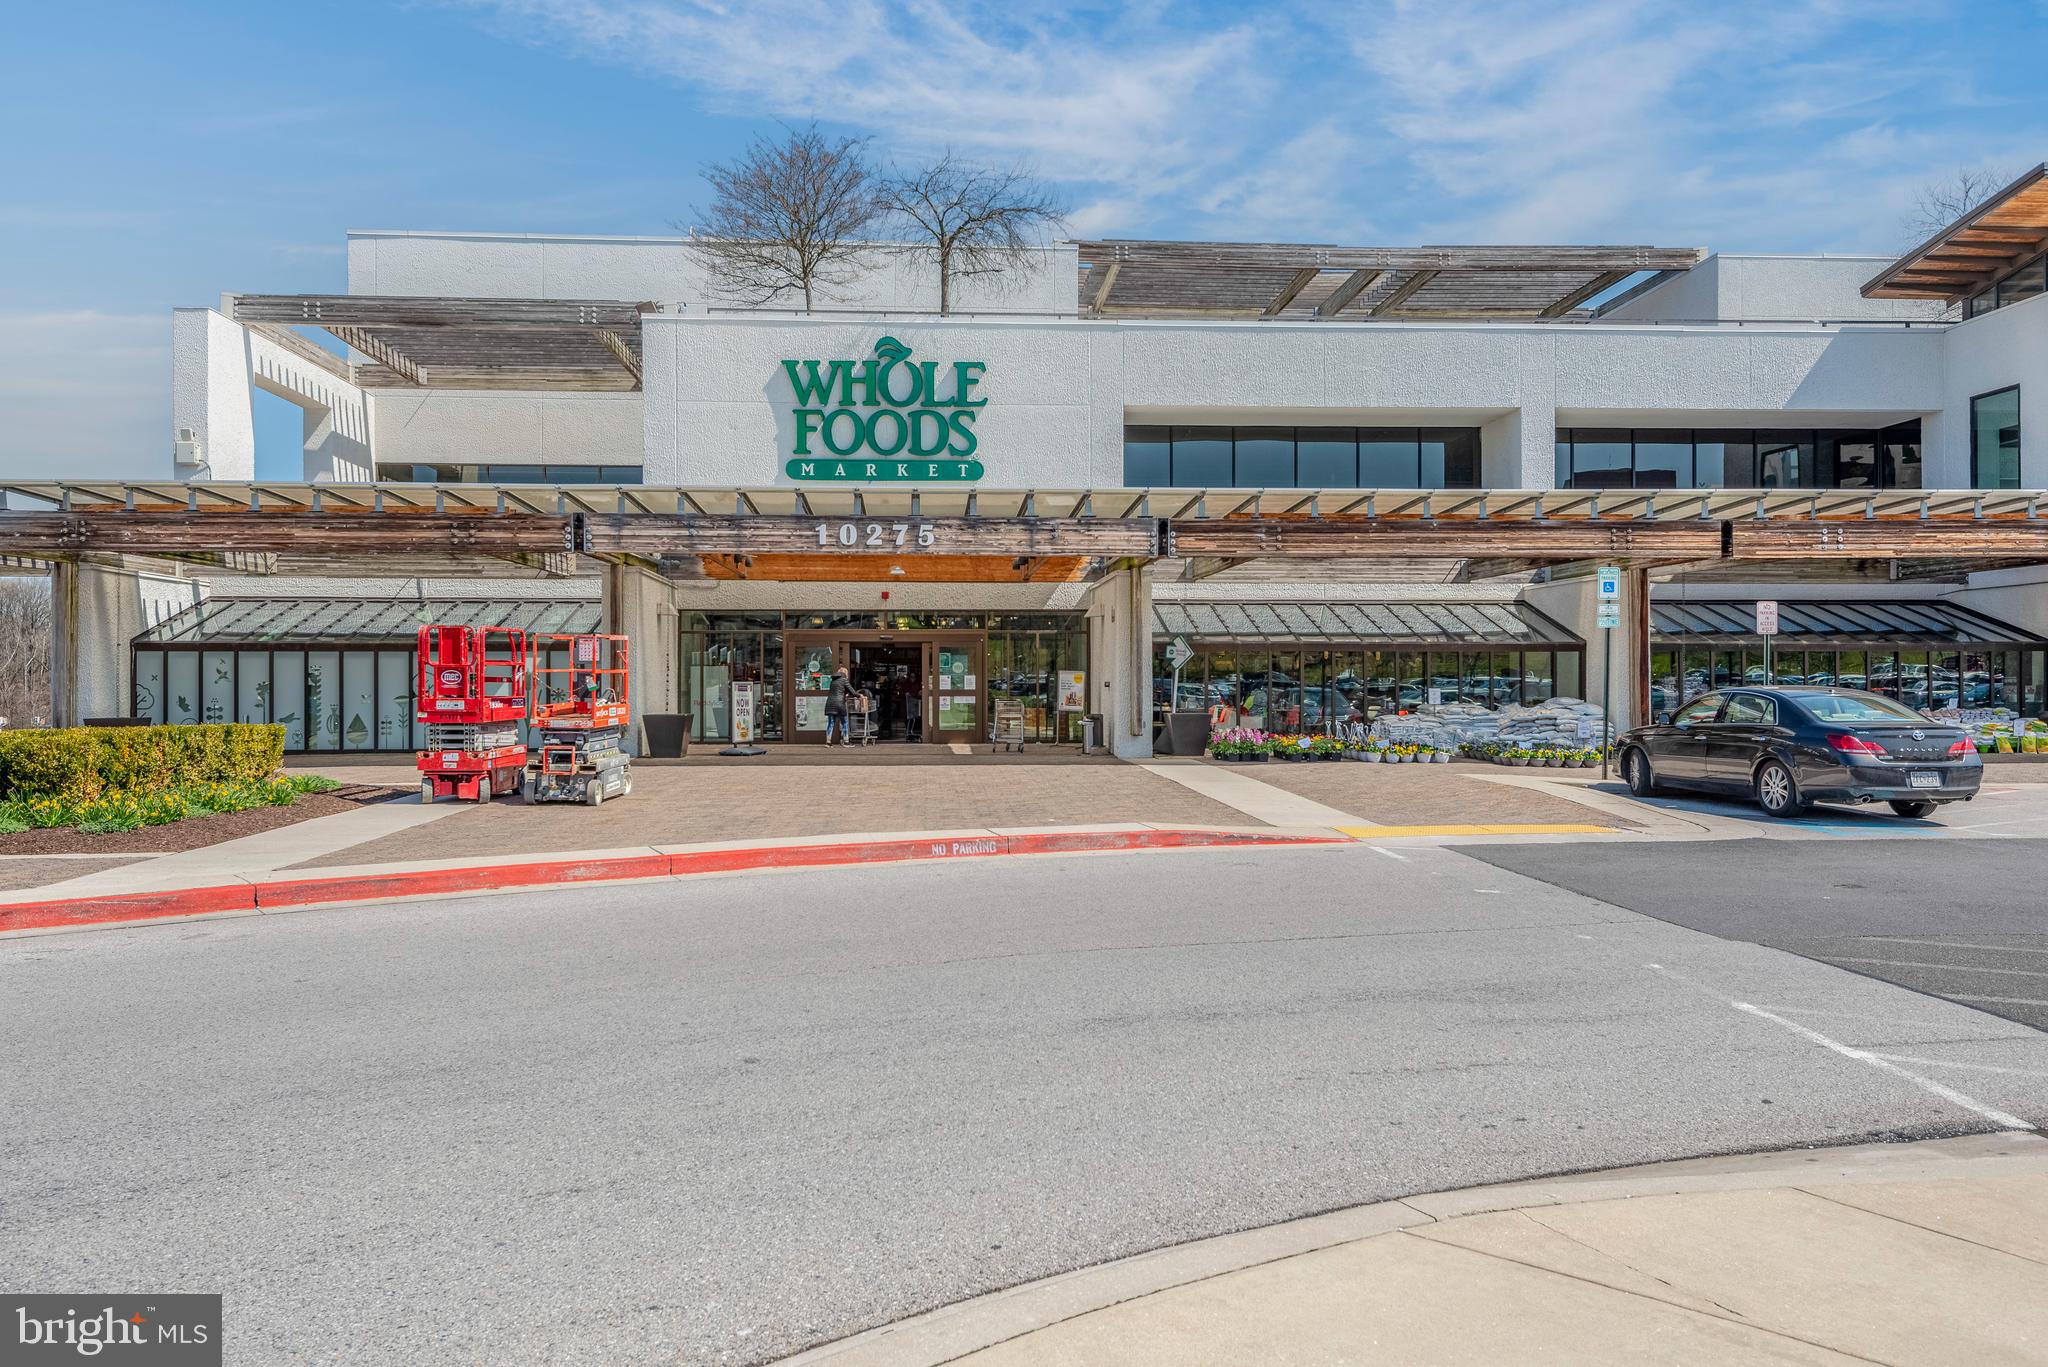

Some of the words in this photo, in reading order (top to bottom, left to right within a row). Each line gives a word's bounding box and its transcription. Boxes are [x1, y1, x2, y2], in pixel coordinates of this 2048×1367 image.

[780, 357, 989, 408] WHOLE
[792, 408, 978, 457] FOODS
[801, 463, 969, 477] MARKET
[815, 523, 935, 546] 10275
[736, 699, 749, 707] NOW
[736, 708, 749, 716] OPEN
[932, 843, 946, 856] NO
[952, 841, 997, 855] PARKING
